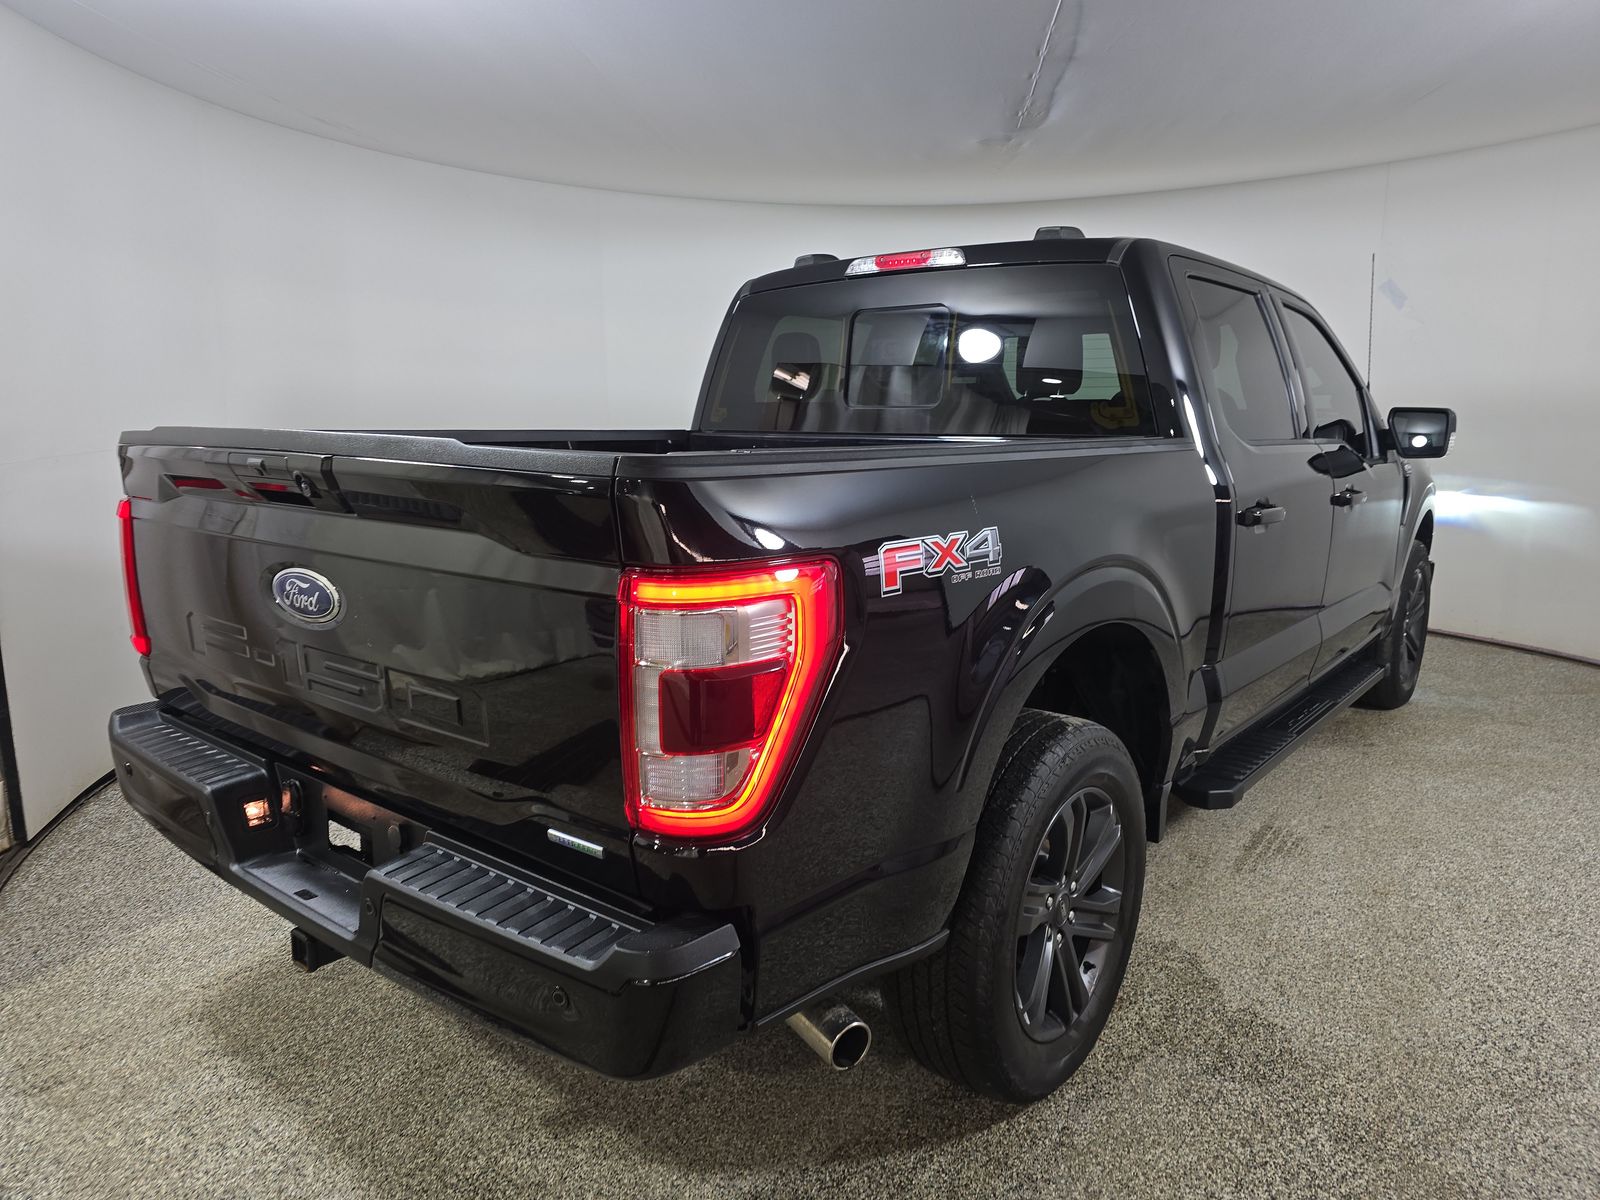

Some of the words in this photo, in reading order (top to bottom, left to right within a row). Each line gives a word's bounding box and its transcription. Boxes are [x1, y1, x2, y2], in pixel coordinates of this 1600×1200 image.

[878, 526, 1003, 598] FX4
[951, 571, 973, 584] OFF
[974, 566, 1002, 579] ROAD
[283, 578, 320, 612] Ford
[186, 611, 490, 747] F-150
